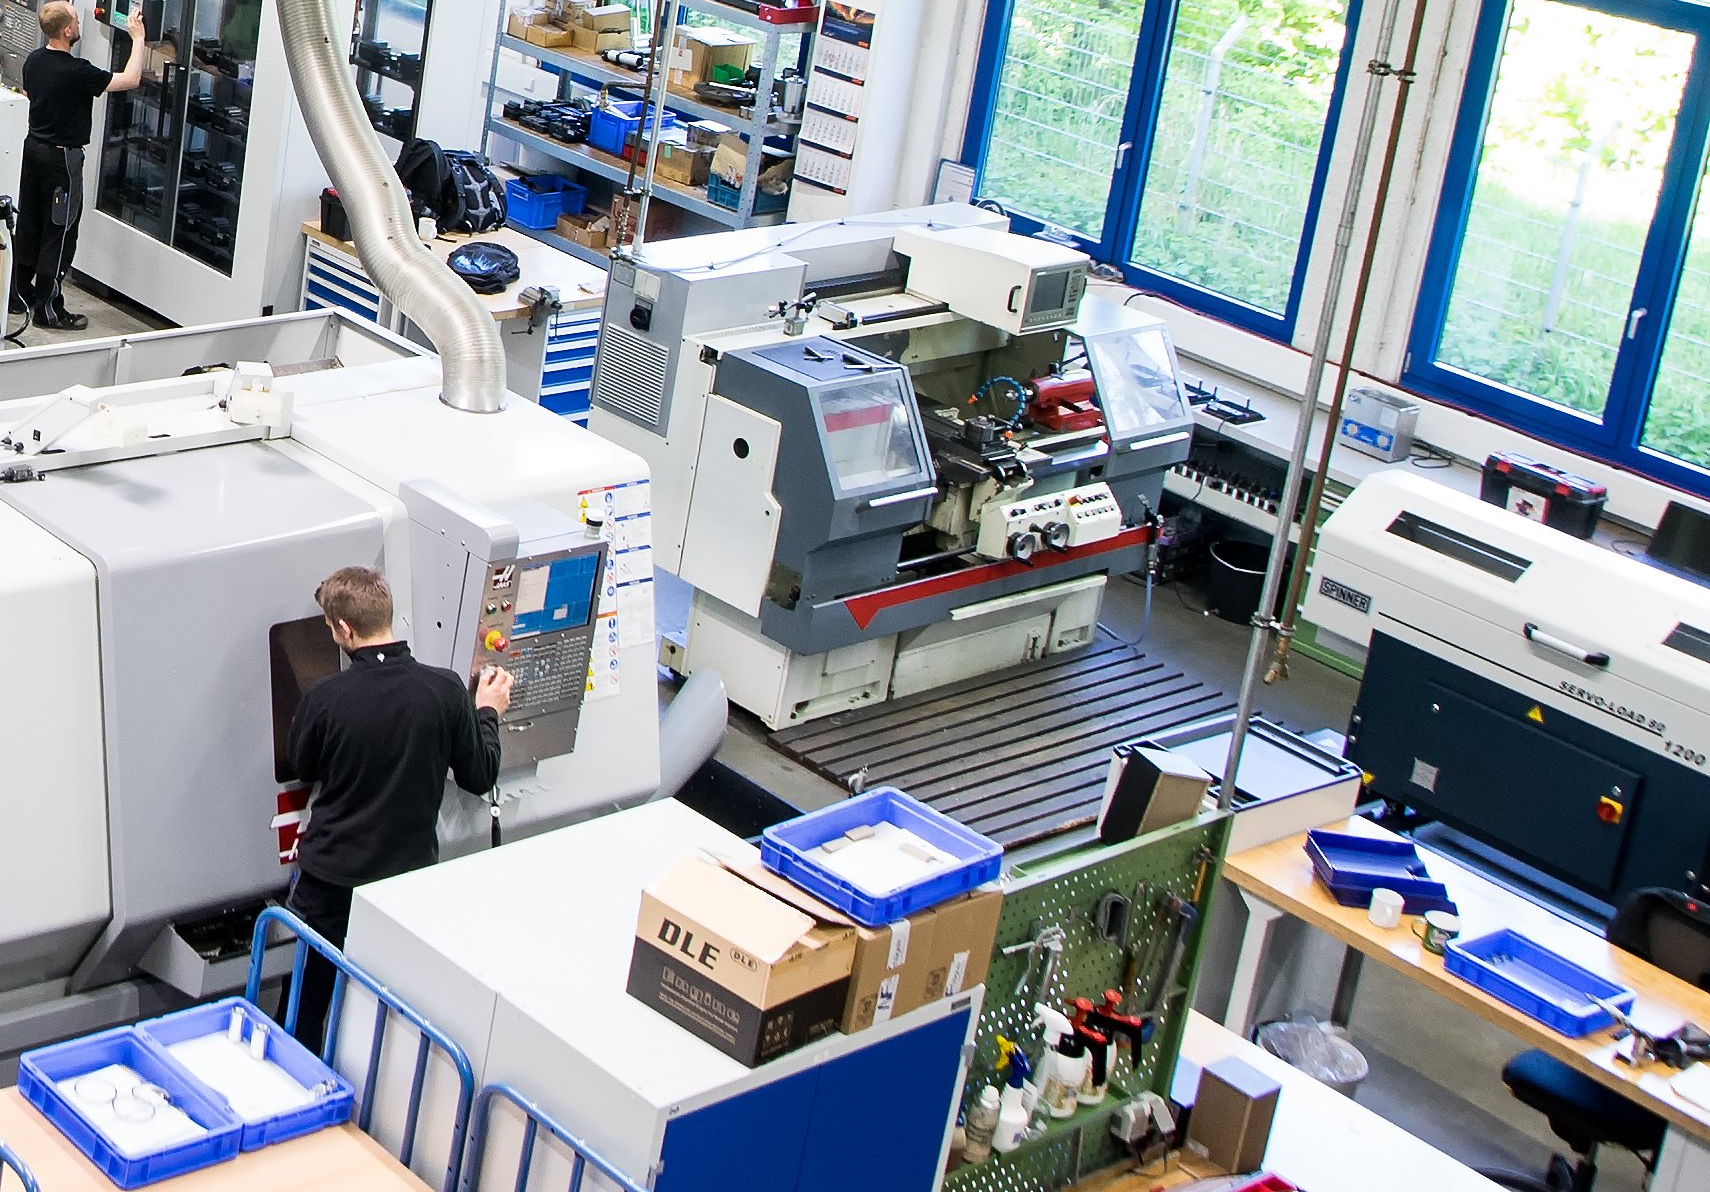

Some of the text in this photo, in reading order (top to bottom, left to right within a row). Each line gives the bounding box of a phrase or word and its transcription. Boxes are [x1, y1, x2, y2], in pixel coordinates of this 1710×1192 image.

[1323, 581, 1368, 609] SPINNER
[1663, 739, 1707, 767] 1200
[657, 917, 721, 971] DLE
